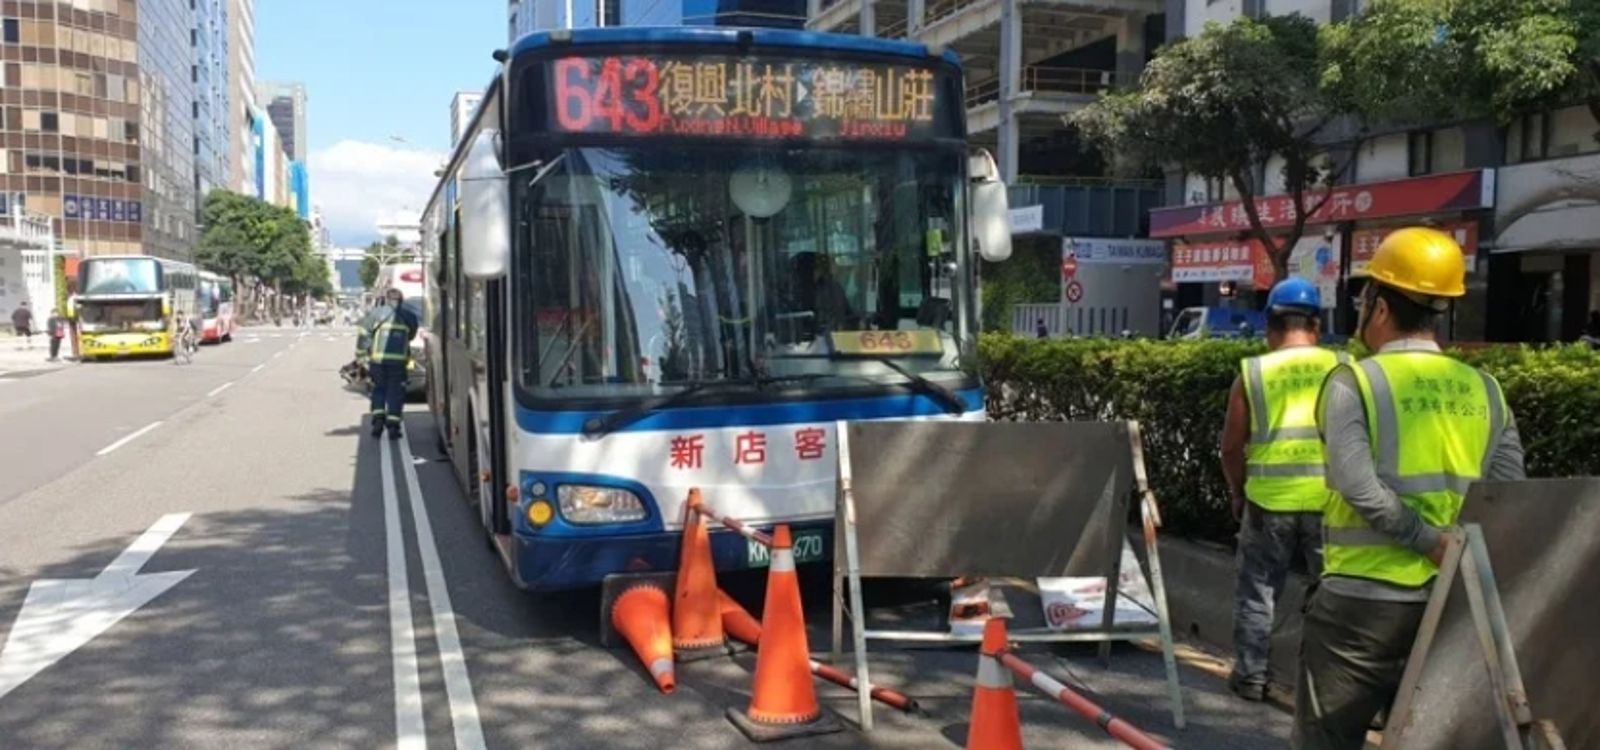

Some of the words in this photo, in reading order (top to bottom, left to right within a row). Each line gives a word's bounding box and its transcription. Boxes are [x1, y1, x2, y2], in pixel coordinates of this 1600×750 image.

[554, 56, 660, 134] 643
[659, 61, 795, 117] 復興北村
[811, 66, 935, 121] 錦繡山莊
[860, 331, 912, 350] 643
[670, 427, 827, 469] 新店客
